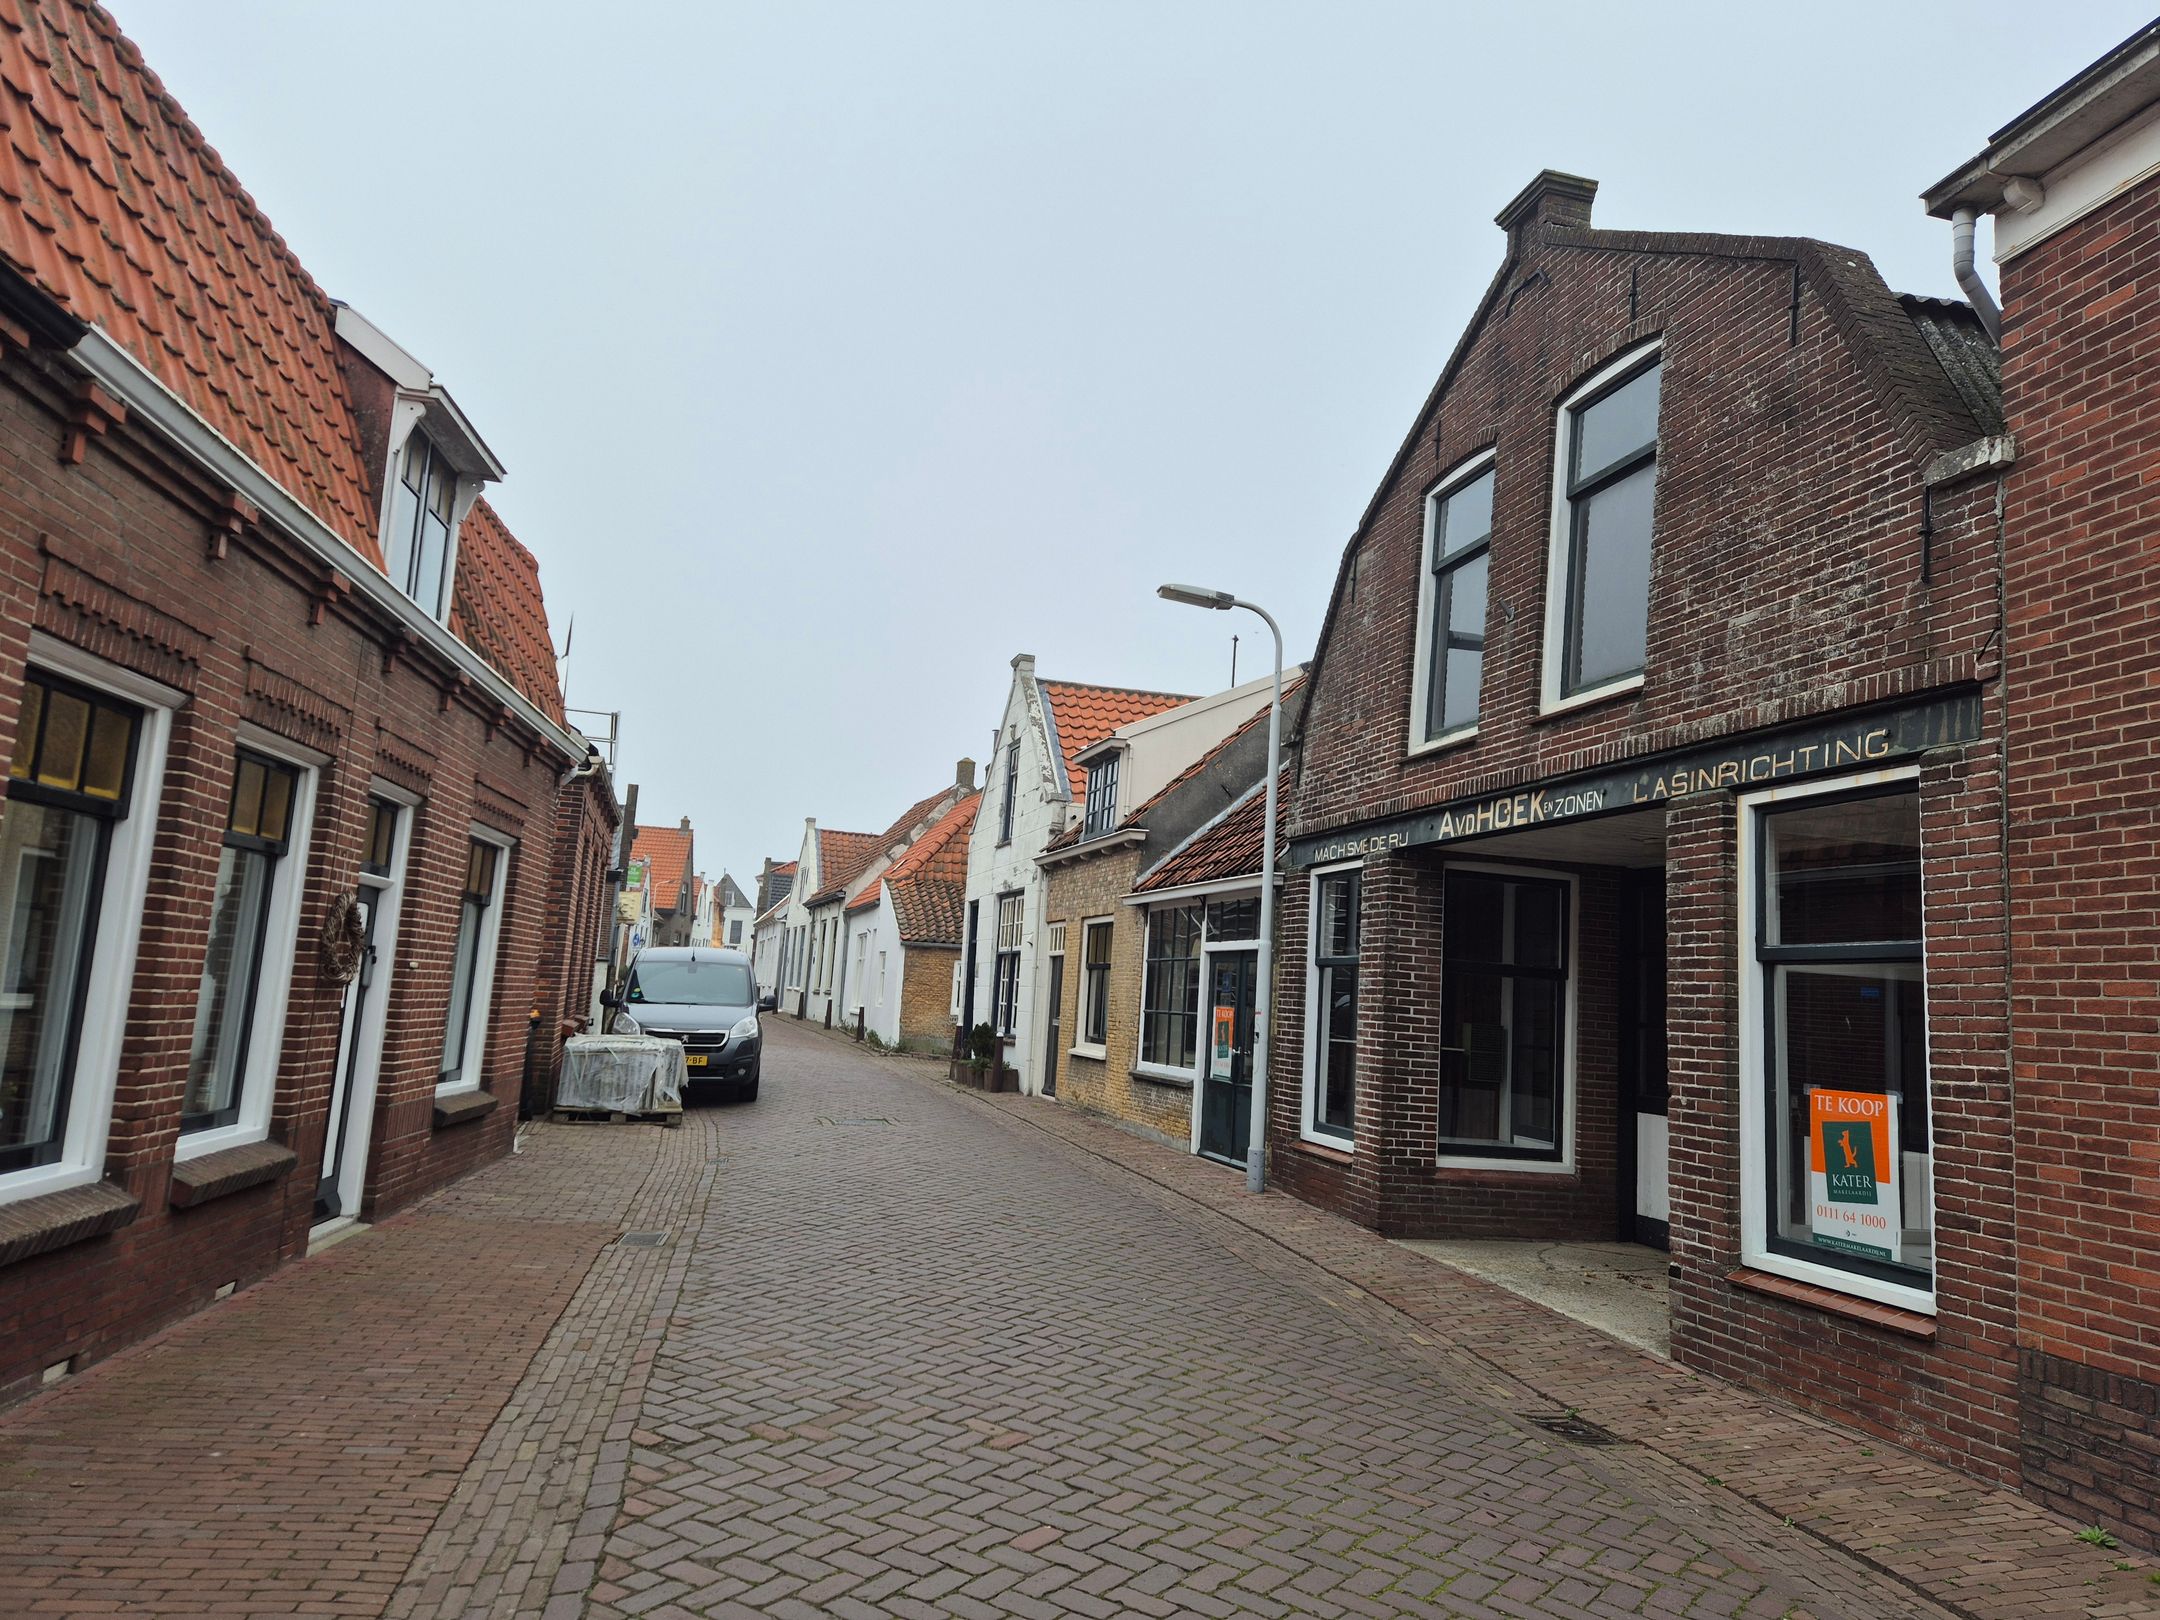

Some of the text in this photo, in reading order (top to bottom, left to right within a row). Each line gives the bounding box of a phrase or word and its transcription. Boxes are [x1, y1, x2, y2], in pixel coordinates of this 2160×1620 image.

[1633, 729, 1890, 803] LASINRICHTING
[1554, 791, 1603, 817] ZONEN
[1815, 1095, 1884, 1117] TE KOOP
[1832, 1174, 1872, 1188] KATER
[1816, 1205, 1887, 1230] 0111 64 1000
